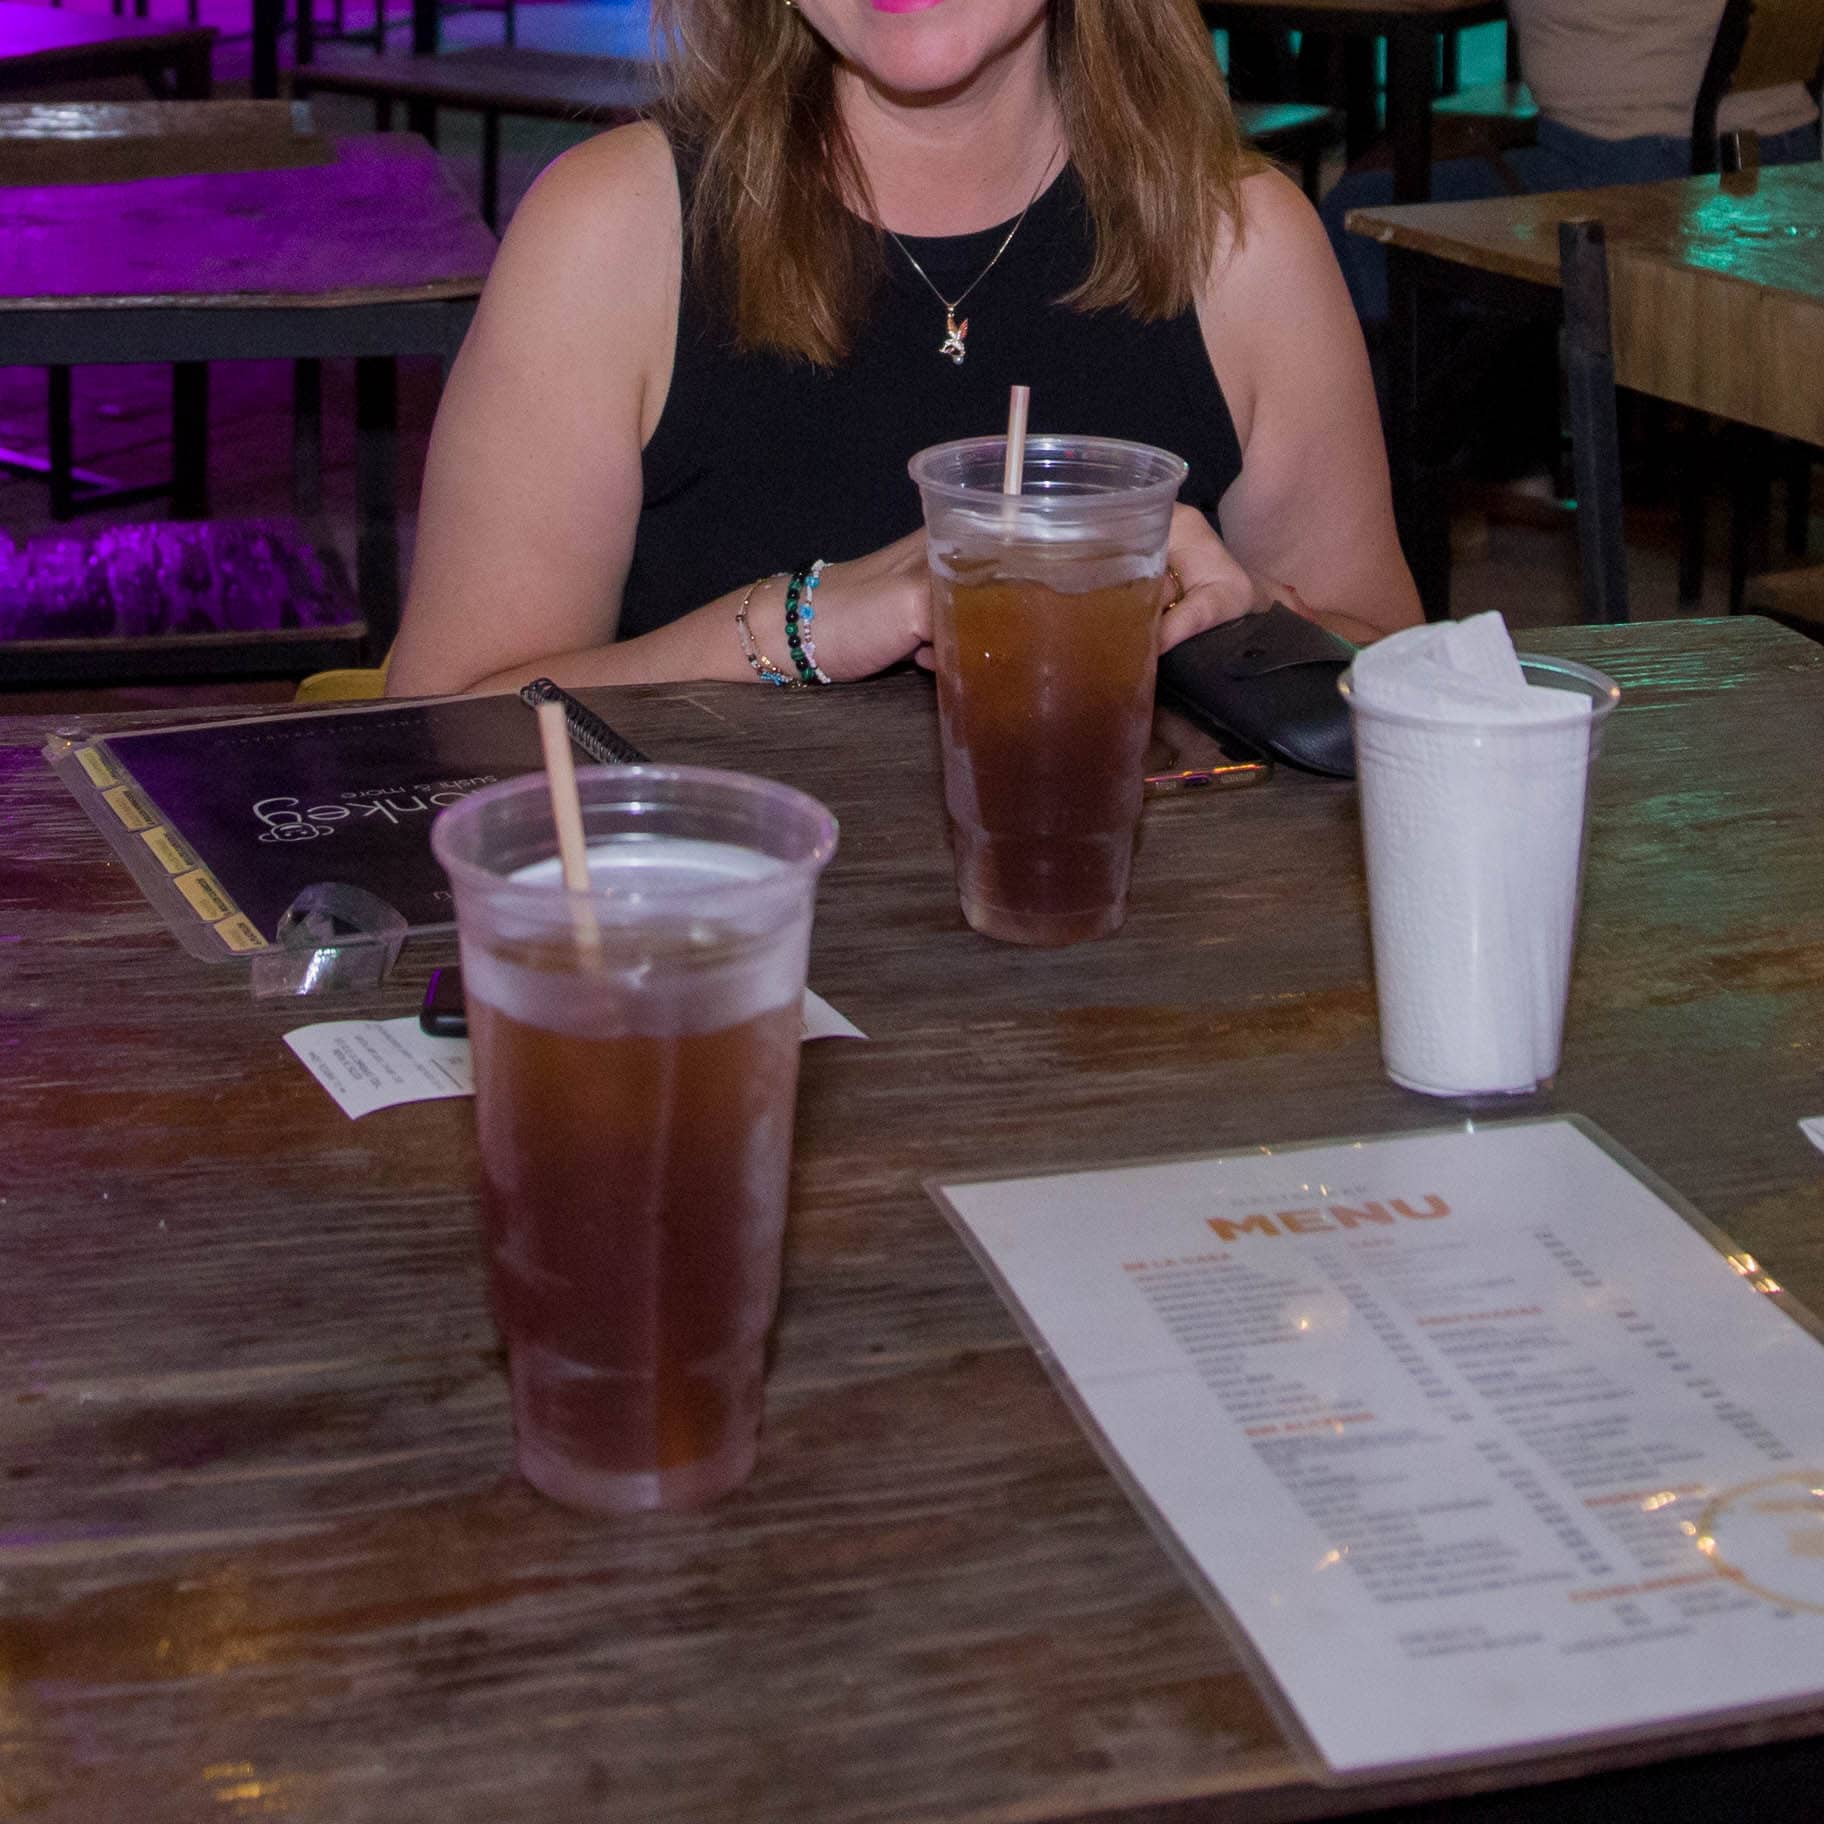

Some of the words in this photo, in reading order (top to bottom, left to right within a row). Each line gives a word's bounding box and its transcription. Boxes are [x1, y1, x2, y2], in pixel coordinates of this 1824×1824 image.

[413, 784, 432, 793] &
[440, 775, 498, 790] sushi
[341, 785, 406, 799] more
[252, 791, 480, 827] onkey
[1206, 1194, 1451, 1243] MENU
